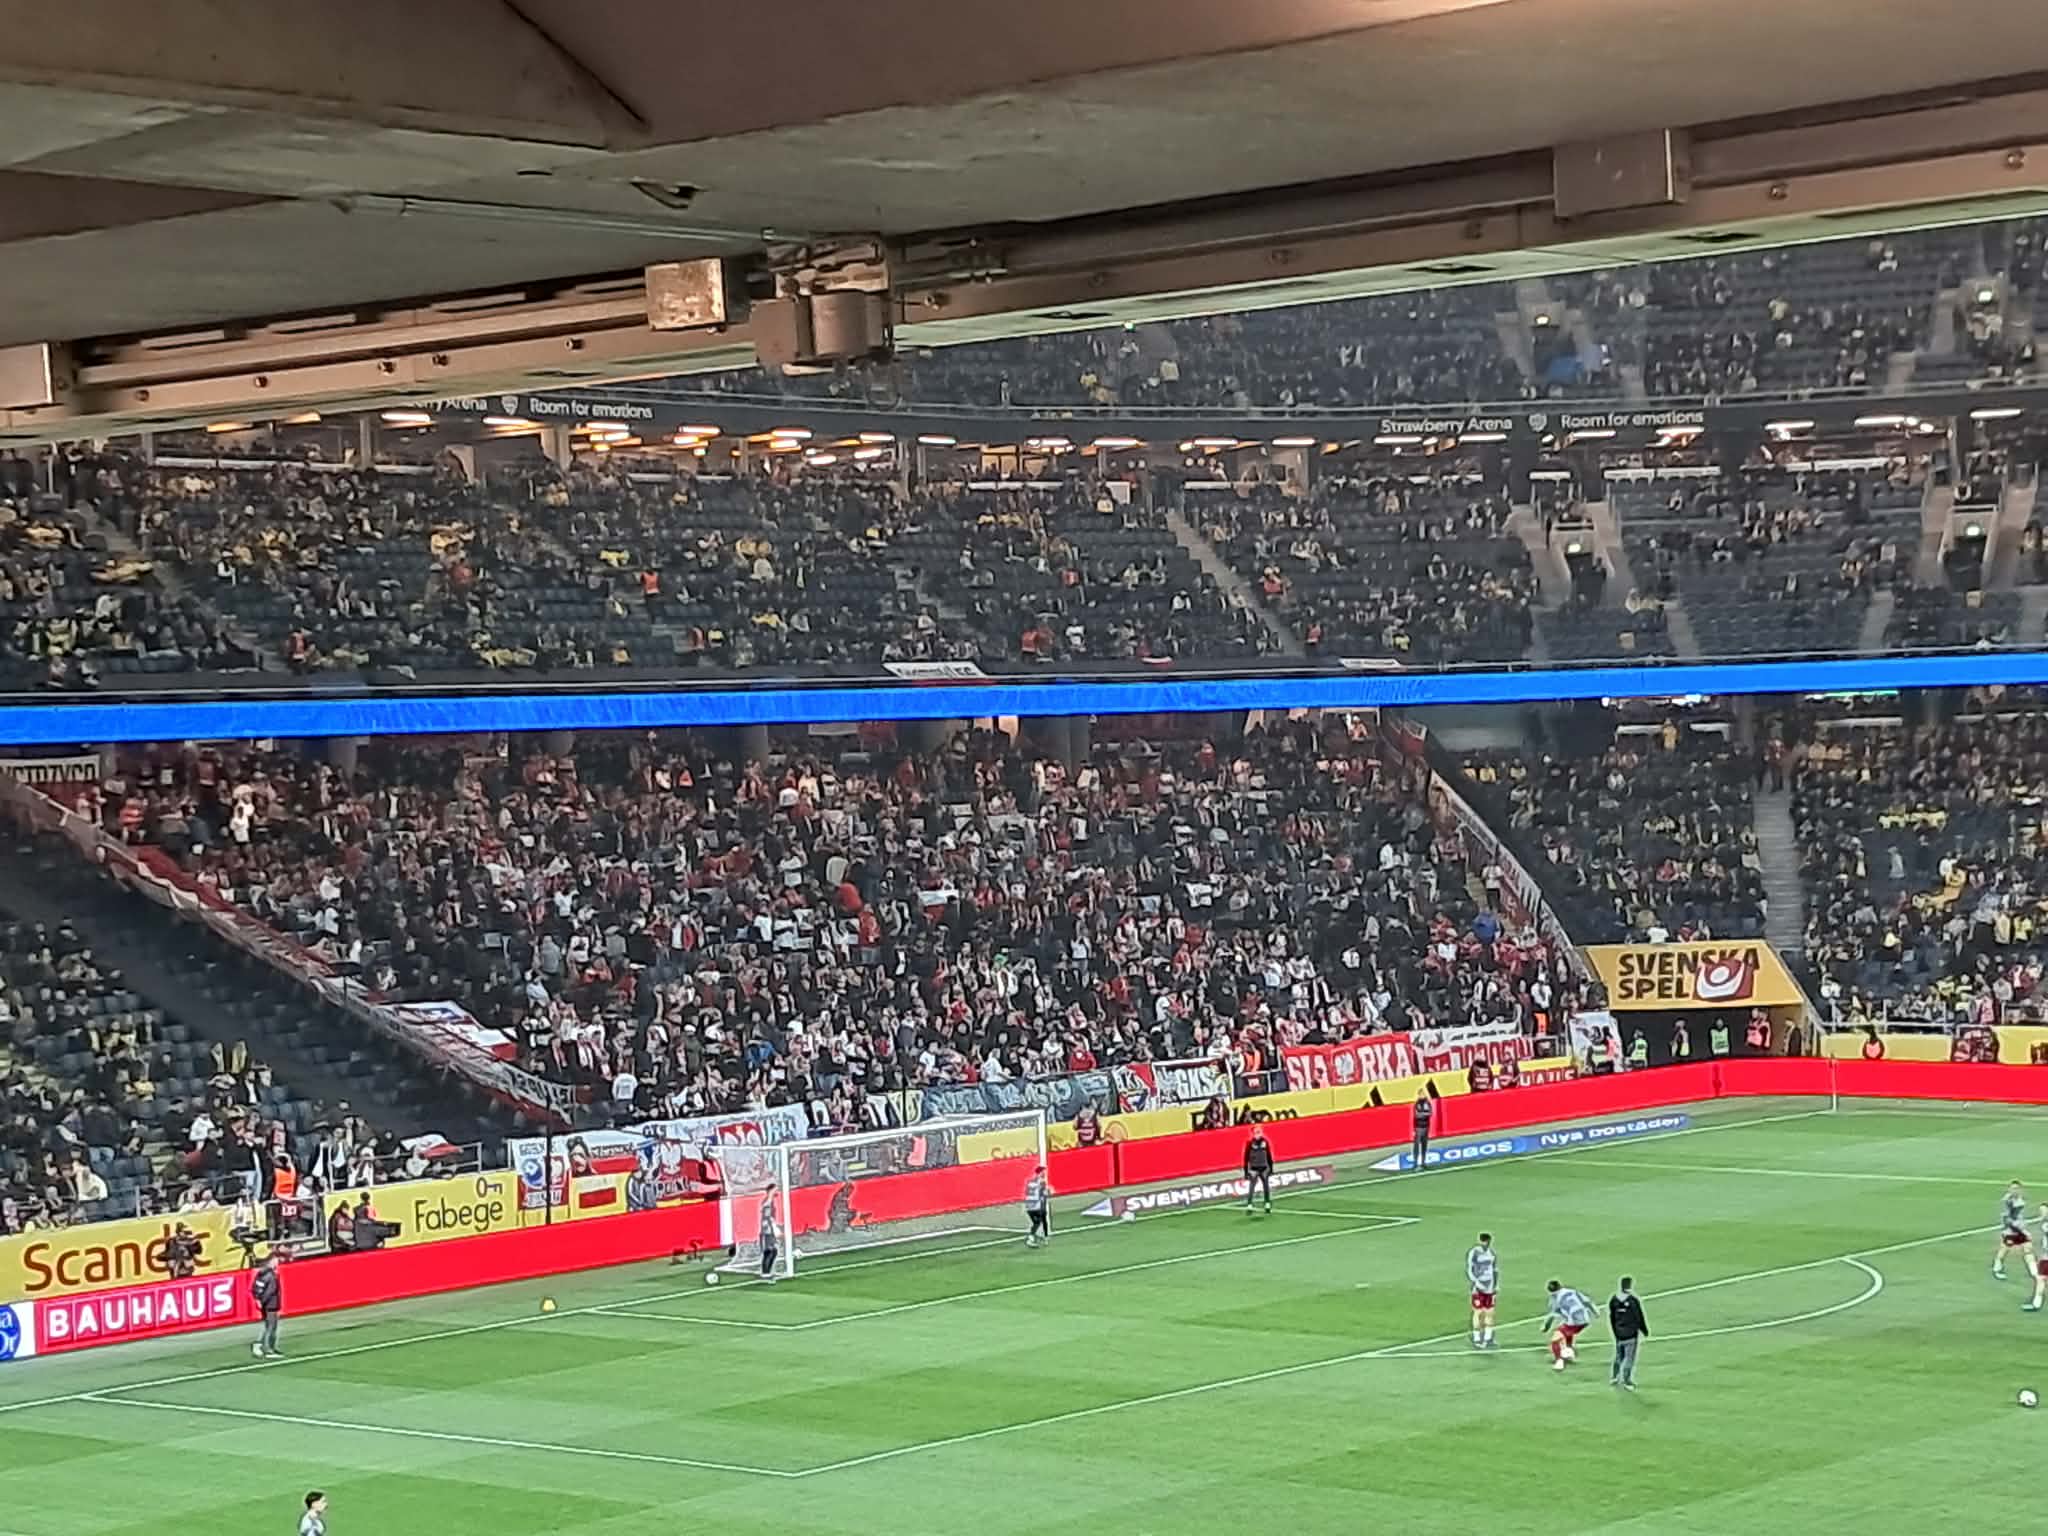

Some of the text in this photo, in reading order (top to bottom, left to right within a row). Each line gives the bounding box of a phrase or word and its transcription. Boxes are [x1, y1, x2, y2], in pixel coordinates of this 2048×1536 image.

[529, 397, 654, 419] Room for emotions
[1380, 416, 1513, 434] Strawberry Arena
[1561, 410, 1705, 429] Room for emotions
[1618, 948, 1760, 977] SVENSKA
[1618, 977, 1690, 999] SPEL
[1541, 1129, 1585, 1146] Nya
[1267, 1168, 1323, 1188] SPEL
[415, 1196, 503, 1233] Fabege
[23, 1223, 212, 1292] Scandc
[48, 1276, 234, 1338] BAUHAUS
